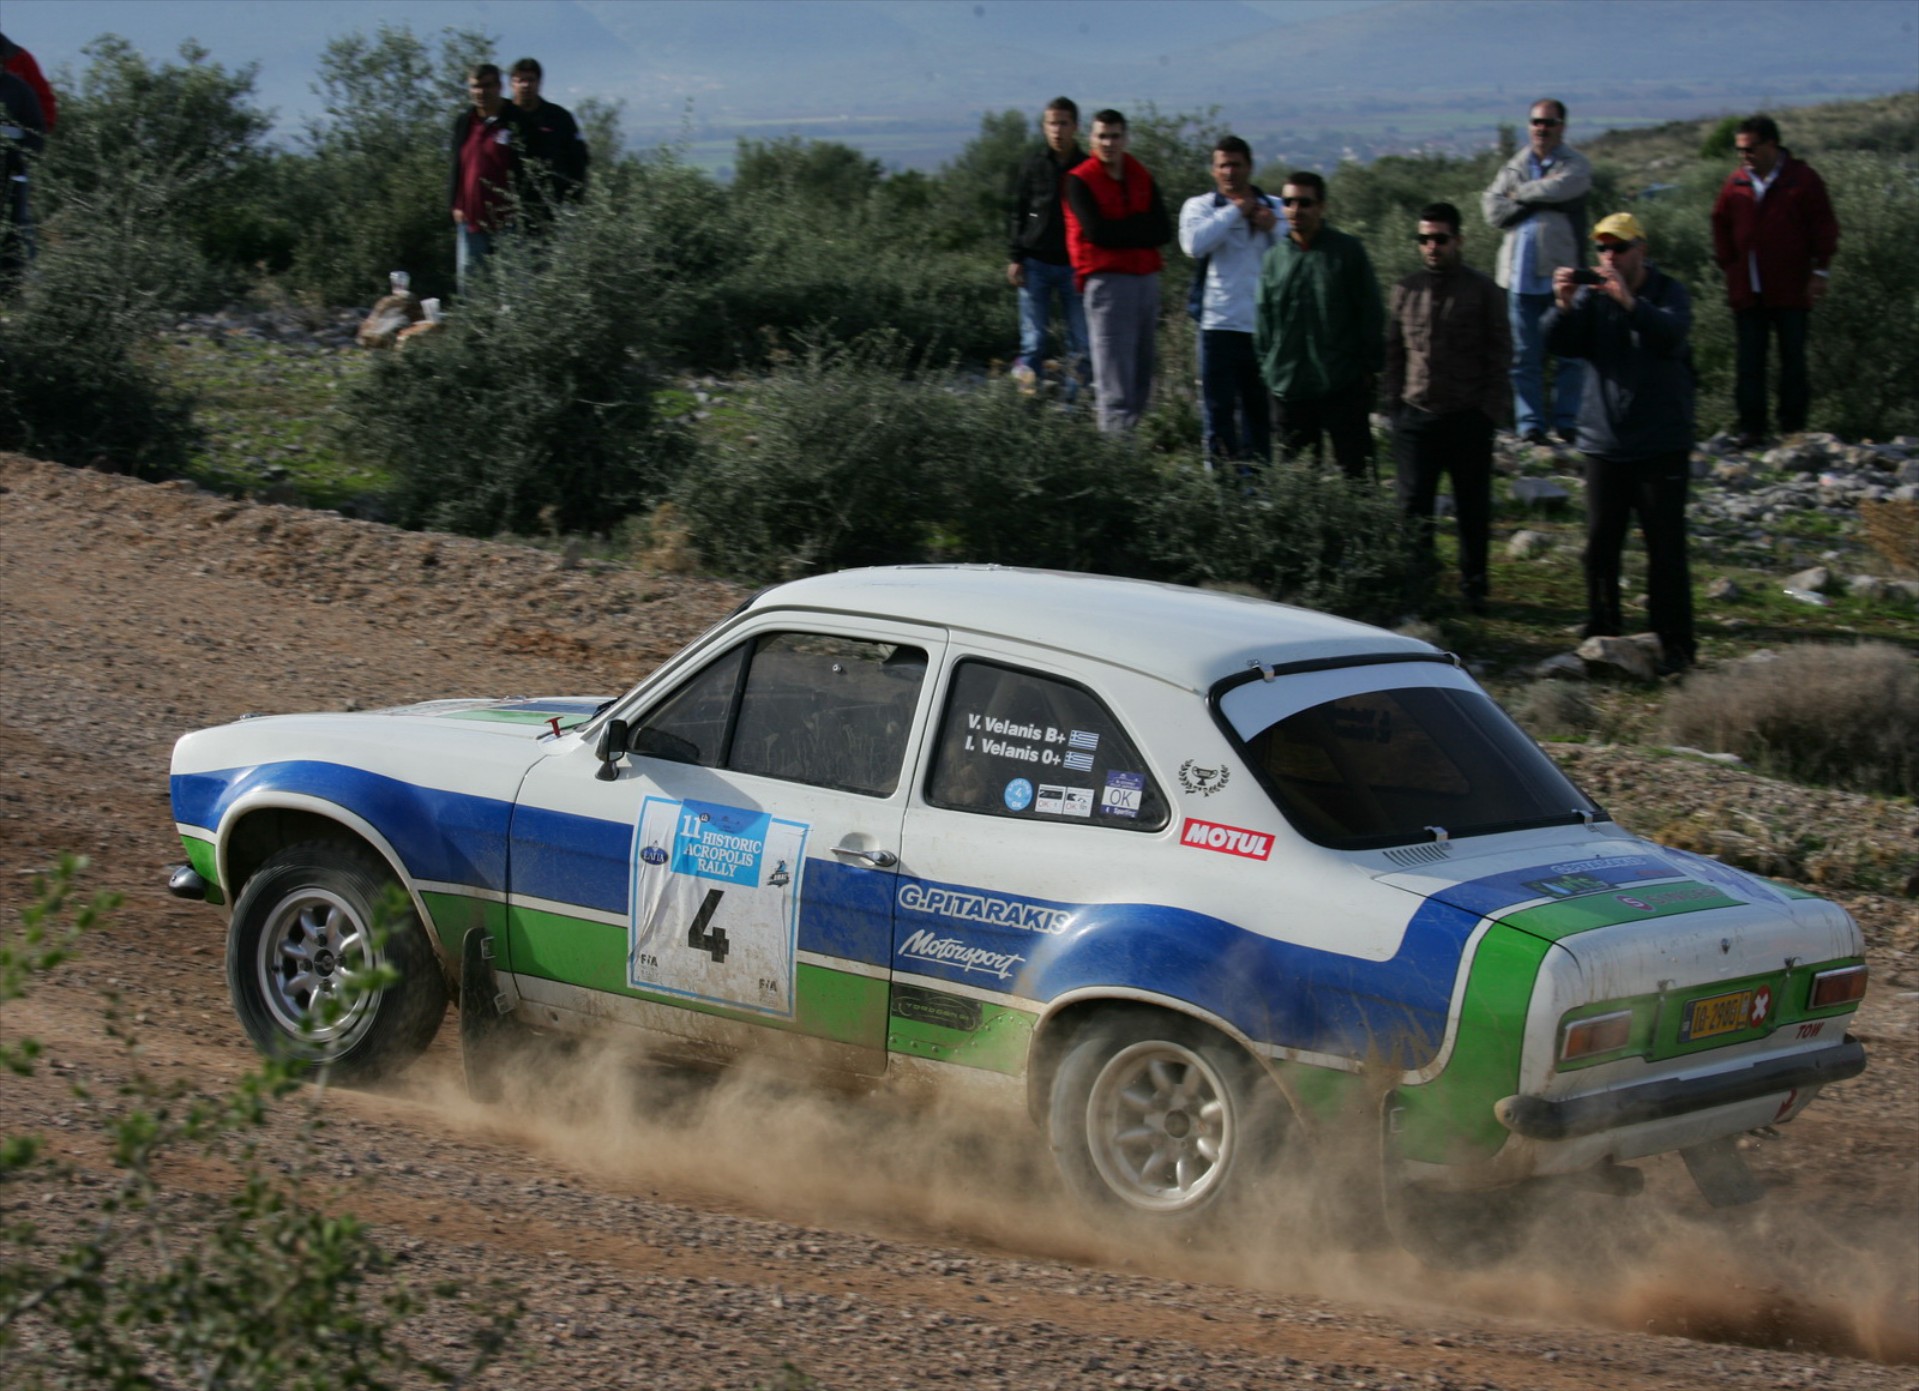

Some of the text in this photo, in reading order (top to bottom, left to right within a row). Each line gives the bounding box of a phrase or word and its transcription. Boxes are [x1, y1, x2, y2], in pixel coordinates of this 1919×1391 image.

[968, 713, 1067, 744] V. Velanis B+
[981, 738, 1039, 762] Velanis
[1108, 788, 1133, 808] OK
[702, 831, 763, 855] HISTORIC
[1184, 822, 1268, 857] MOTUL
[684, 843, 754, 867] ACROPOLIS
[697, 858, 738, 878] RALLY
[899, 884, 1073, 935] G.PITARAKIS
[688, 888, 729, 963] 4
[898, 929, 1026, 980] Motorsport
